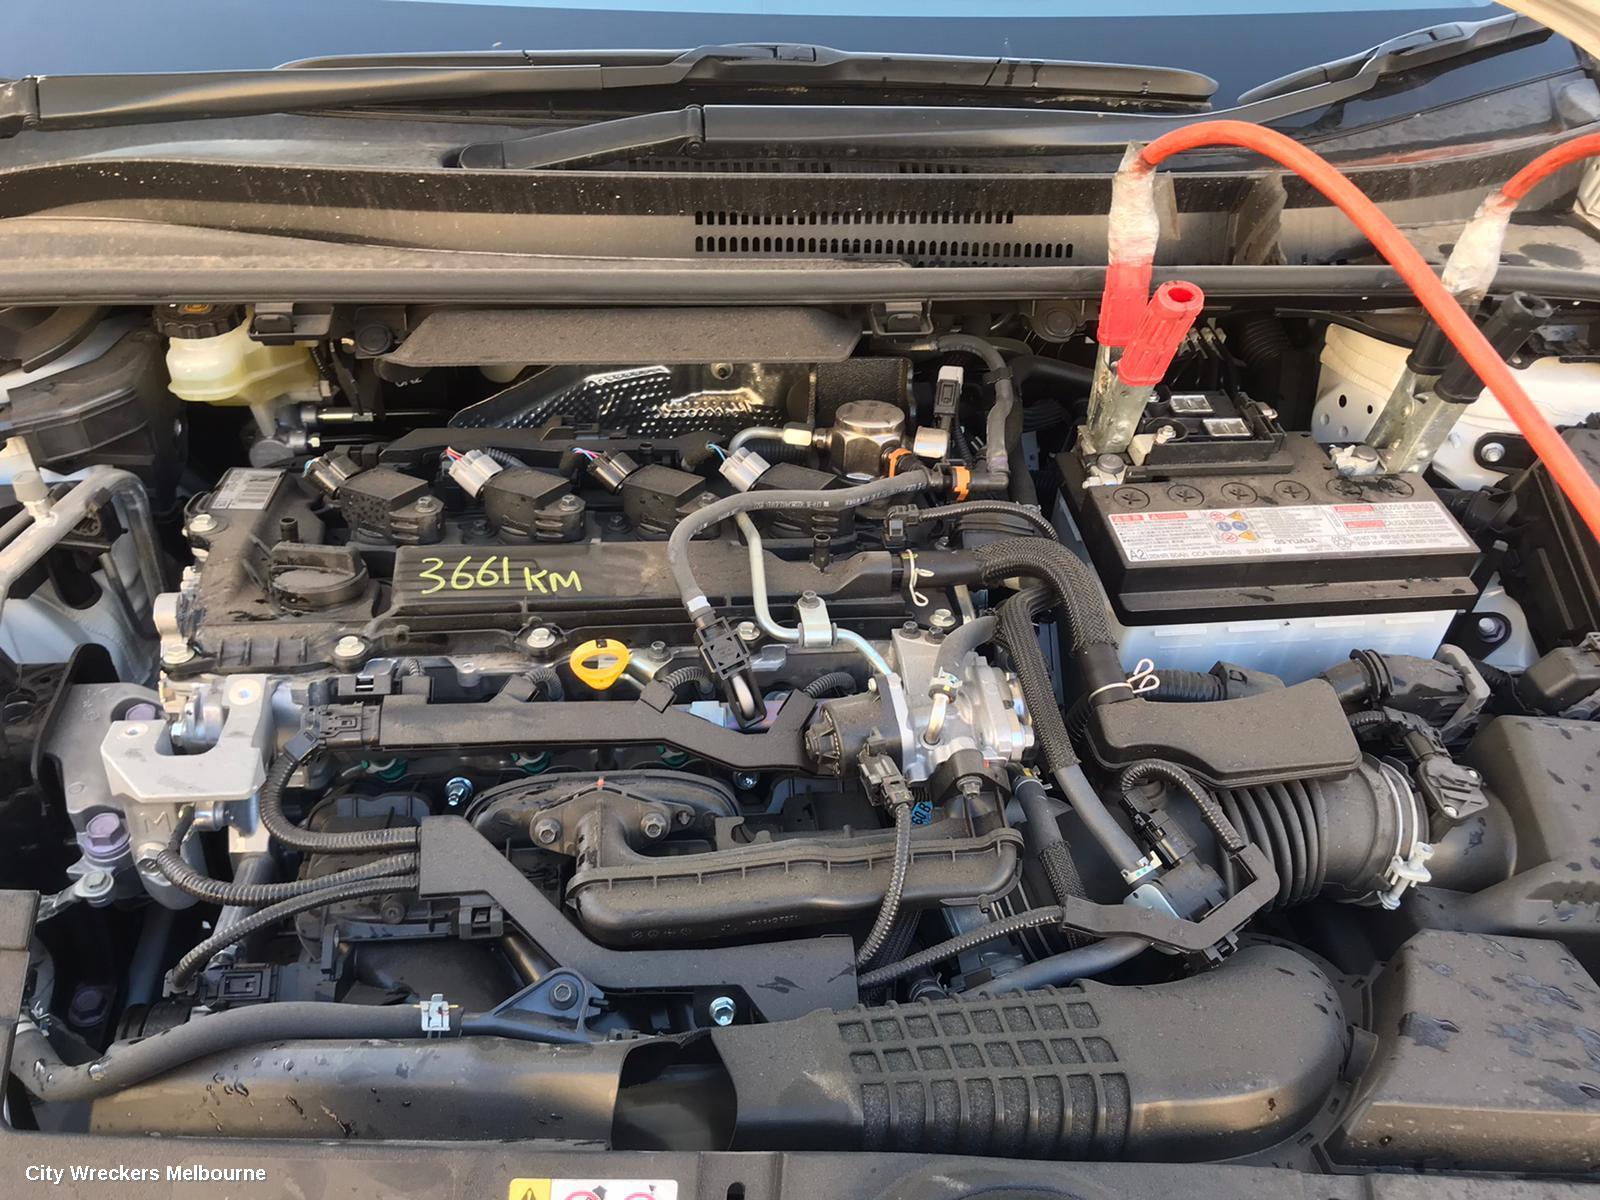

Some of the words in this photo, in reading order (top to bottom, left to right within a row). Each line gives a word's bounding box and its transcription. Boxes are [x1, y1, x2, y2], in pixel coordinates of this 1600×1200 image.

[1130, 549, 1147, 560] A2
[419, 556, 510, 594] 3661
[523, 566, 582, 594] KM
